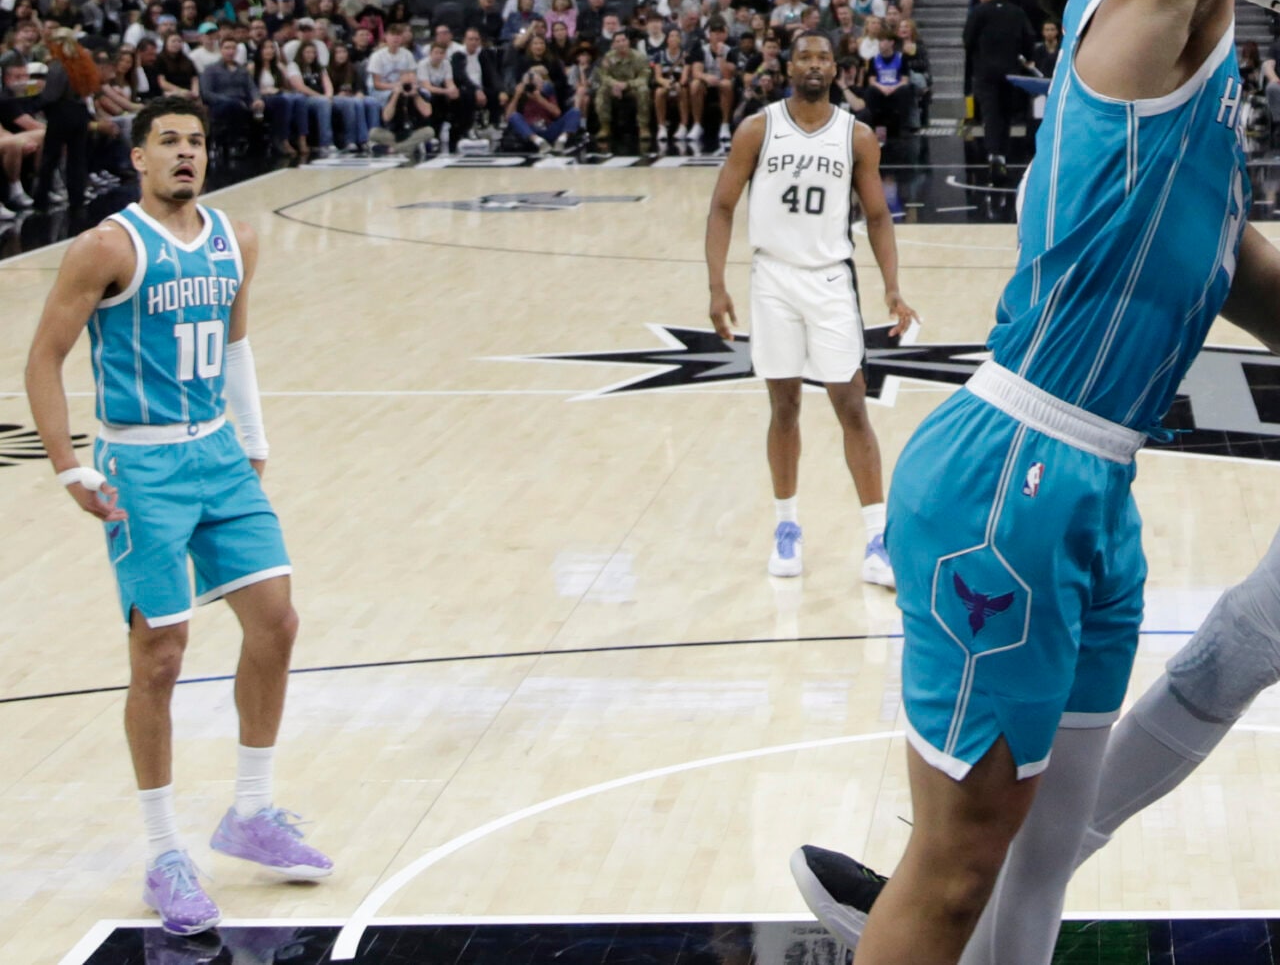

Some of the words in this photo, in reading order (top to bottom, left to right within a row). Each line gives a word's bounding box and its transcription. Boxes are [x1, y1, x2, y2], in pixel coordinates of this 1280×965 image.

[781, 185, 826, 215] 40
[147, 275, 241, 316] HORNETS
[174, 319, 225, 382] 10
